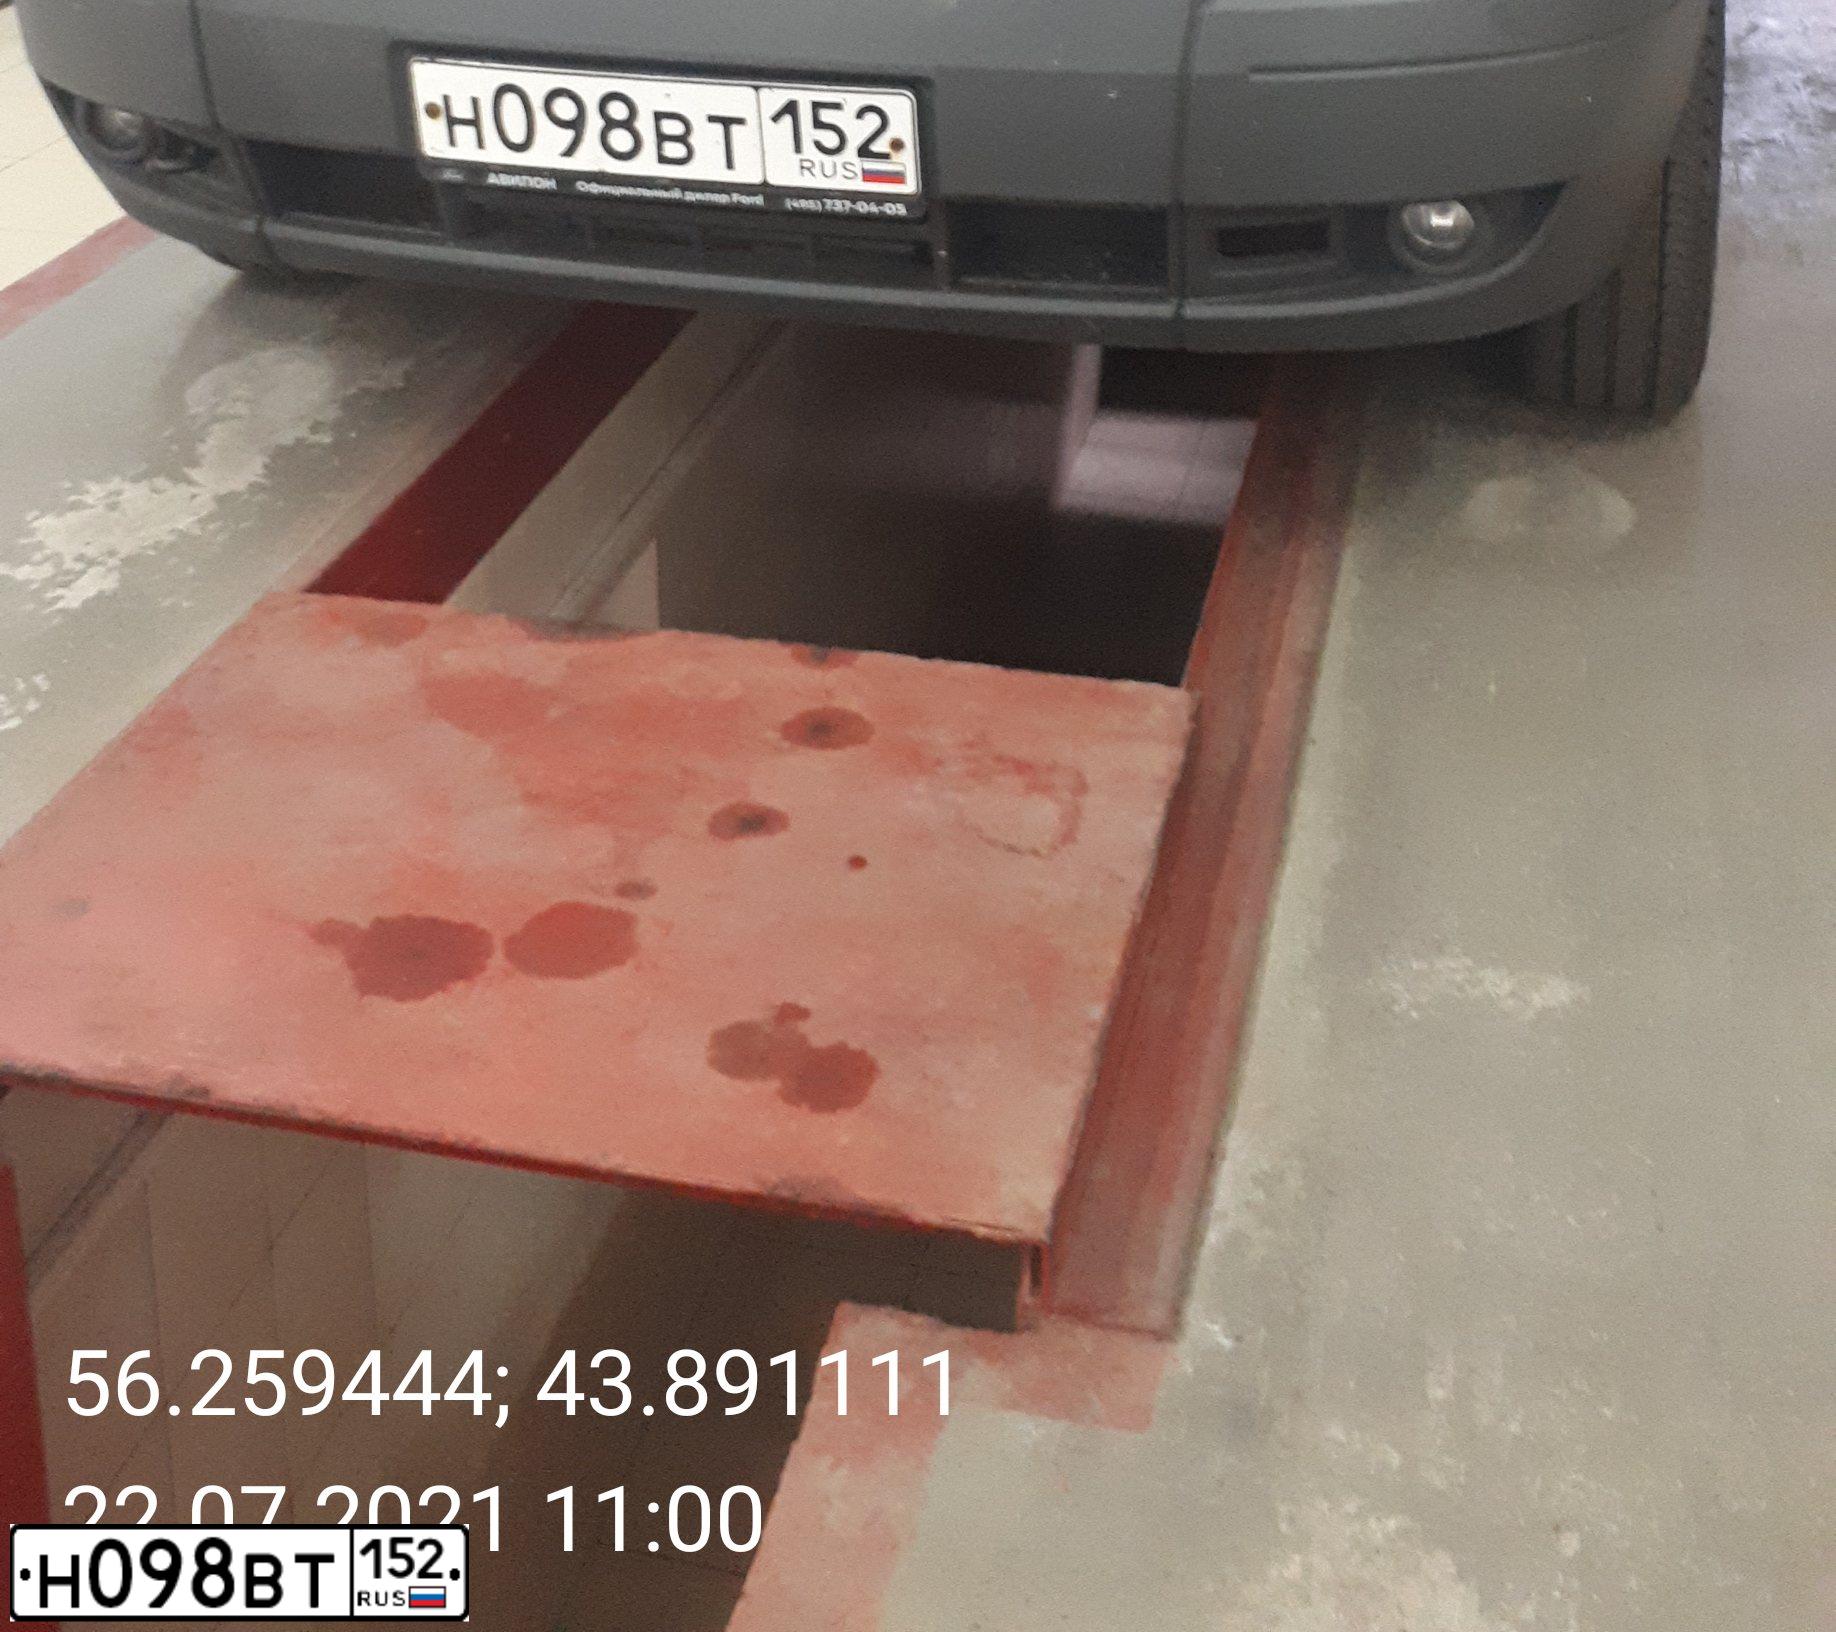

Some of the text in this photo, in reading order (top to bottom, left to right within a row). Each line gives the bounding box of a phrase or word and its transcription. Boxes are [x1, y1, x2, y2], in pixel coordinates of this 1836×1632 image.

[442, 83, 892, 171] Н098ВТ 152
[800, 158, 859, 180] RUS
